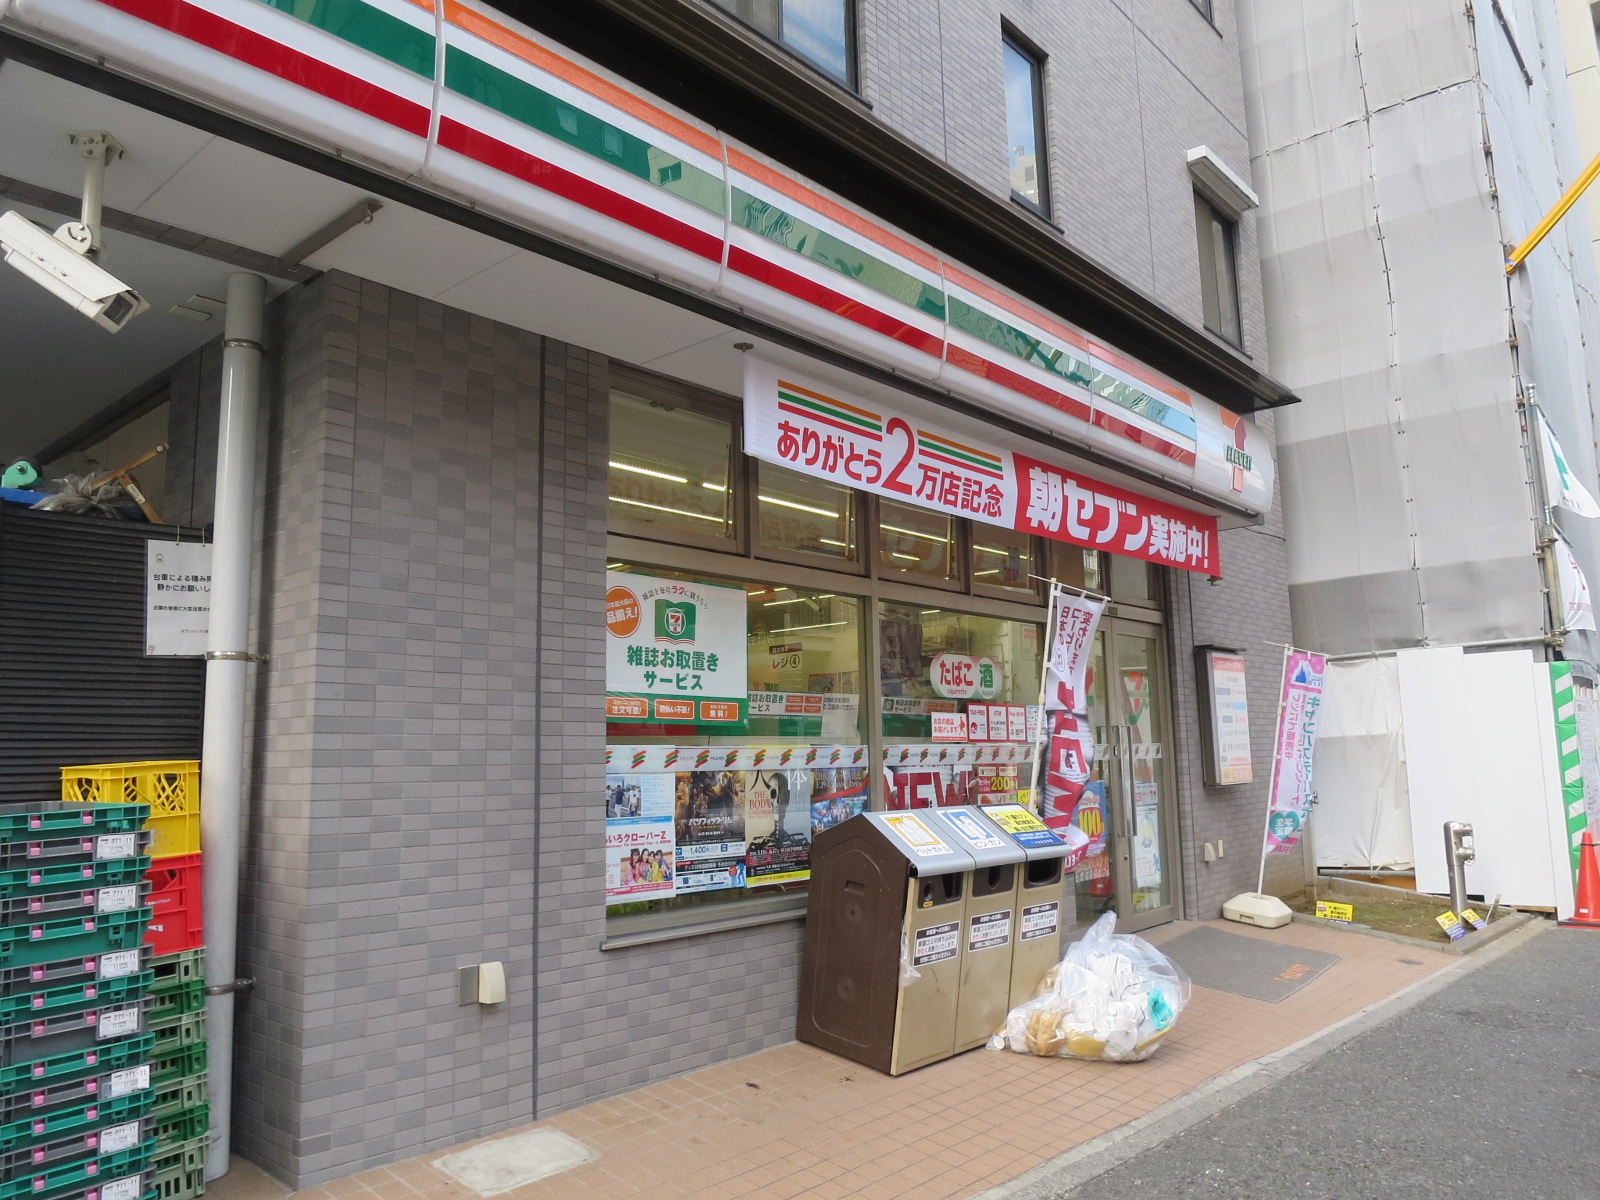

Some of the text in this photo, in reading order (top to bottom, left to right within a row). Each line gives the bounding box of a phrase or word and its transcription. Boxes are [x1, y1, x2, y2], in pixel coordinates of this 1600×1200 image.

[777, 417, 1005, 517] ありがとう2万店記念
[1027, 466, 1210, 569] 朝セブン実施中!
[627, 645, 719, 672] 雑誌お取置き
[643, 670, 703, 690] サービス
[939, 660, 994, 689] たばこ 酒
[754, 791, 766, 800] THE
